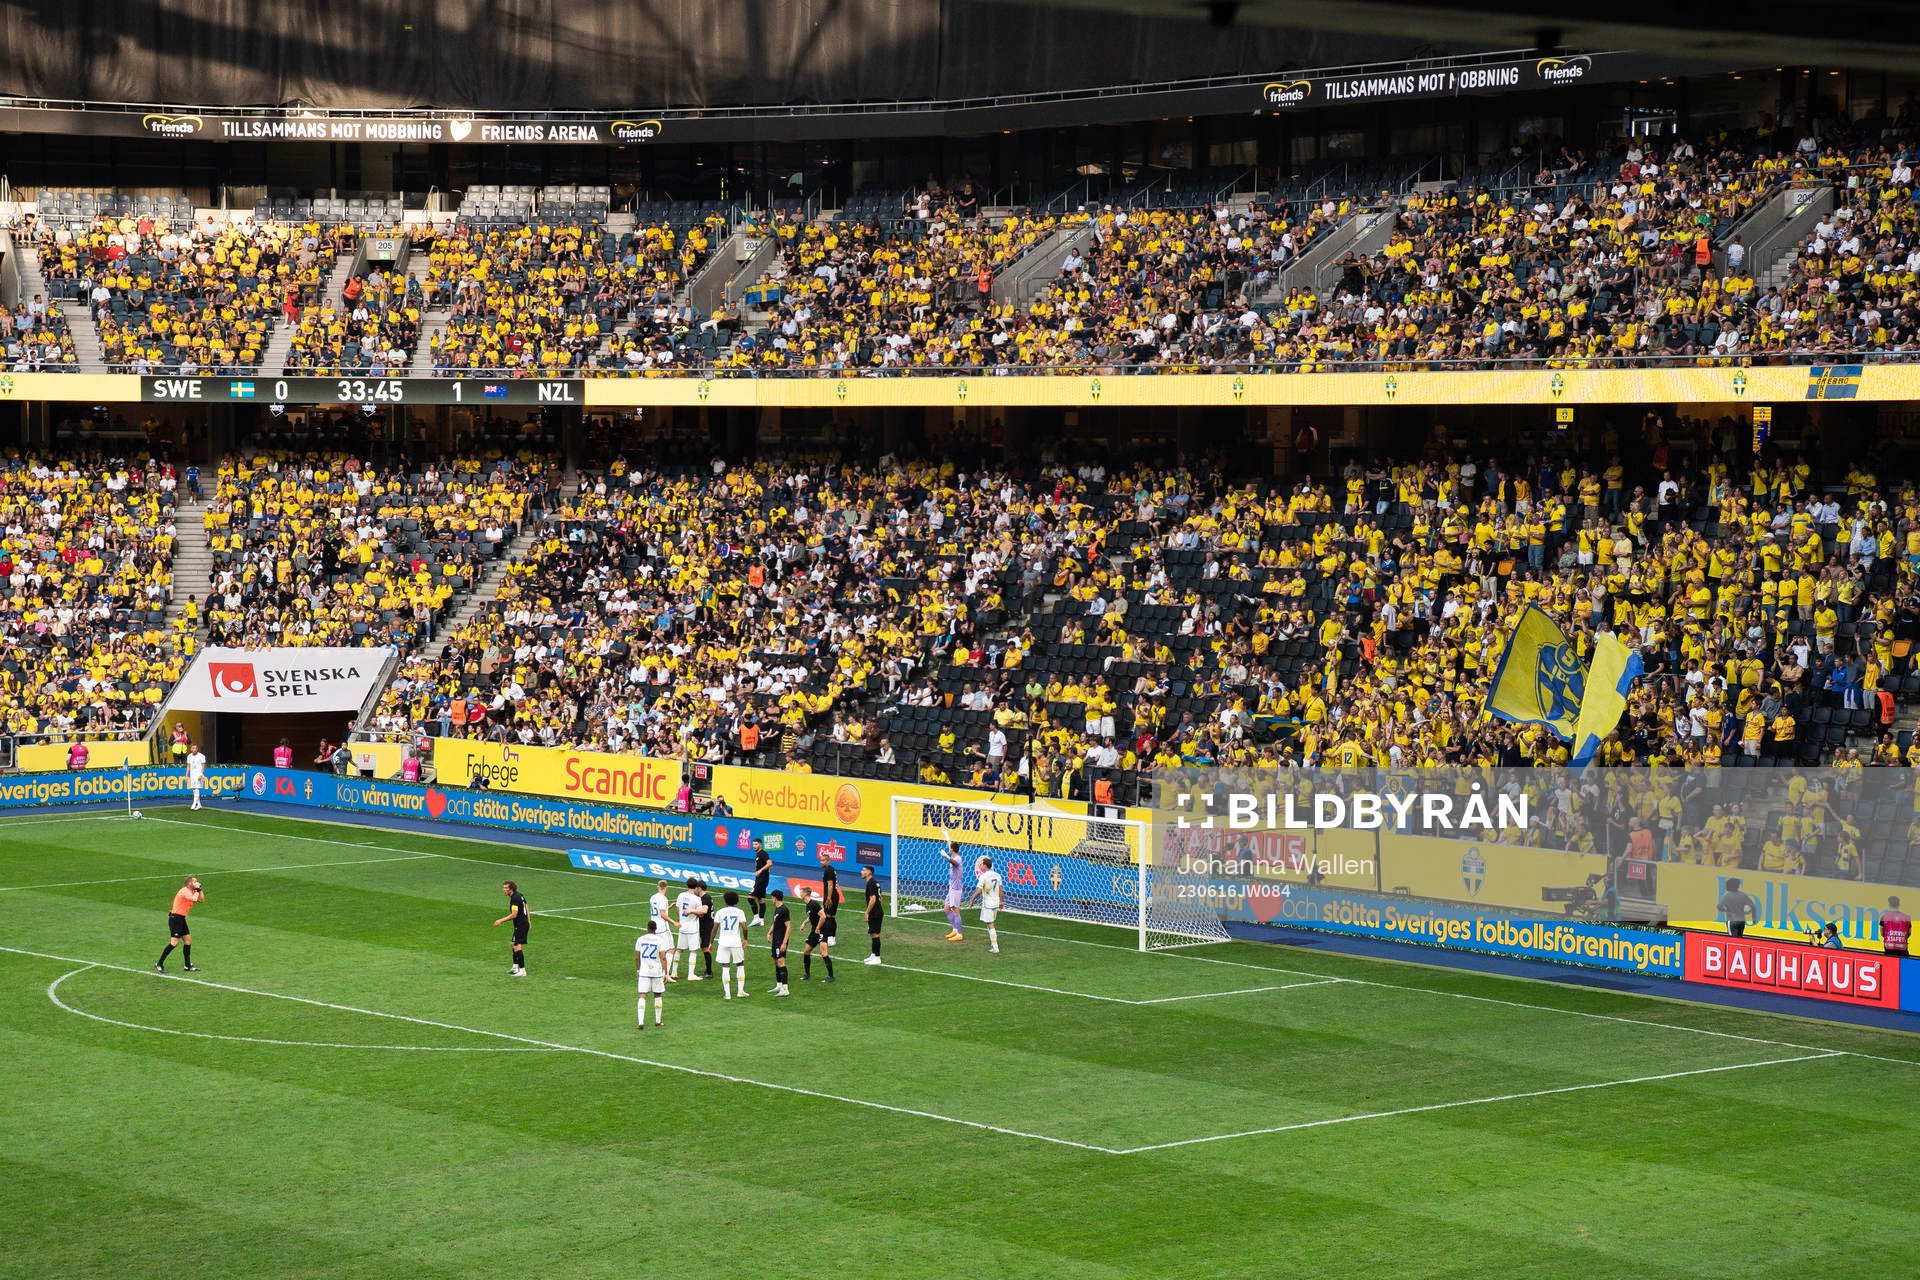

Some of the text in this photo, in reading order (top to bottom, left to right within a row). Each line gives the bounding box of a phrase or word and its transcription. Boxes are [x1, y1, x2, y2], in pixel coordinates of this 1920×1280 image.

[1544, 65, 1583, 80] friends
[1325, 76, 1414, 99] TILLSAMMANS
[1418, 73, 1446, 92] MOT
[1270, 88, 1304, 103] friends
[151, 120, 194, 134] friends
[222, 121, 598, 141] TILLSAMMANS MOT MOBBNING FRIENDS ARENA
[618, 124, 654, 138] friends
[378, 241, 393, 250] 205
[745, 241, 759, 250] 204
[153, 379, 574, 402] SWE 0 33:45 1 NZL
[263, 667, 361, 683] SVENSKA
[265, 684, 317, 698] SPEL
[1344, 752, 1353, 764] 12
[466, 754, 666, 801] Fabege Scandic
[275, 777, 297, 796] ICA
[739, 782, 830, 813] Swedbank
[336, 783, 693, 845] Köp våra varor och stötta Sveriges fotbollsföreningar!
[1187, 829, 1302, 863] AUHAUS
[582, 854, 755, 889] Heja Sverige
[1008, 861, 1037, 886] ICA
[1632, 866, 1643, 874] 140
[991, 879, 998, 891] 7
[723, 915, 738, 931] 17
[1282, 896, 1317, 920] och
[1323, 899, 1380, 928] stötta
[1384, 906, 1471, 943] Sveriges
[1476, 916, 1681, 969] fotbollsföreningar!
[641, 943, 658, 959] 22
[1705, 946, 1877, 992] BAUHAUS
